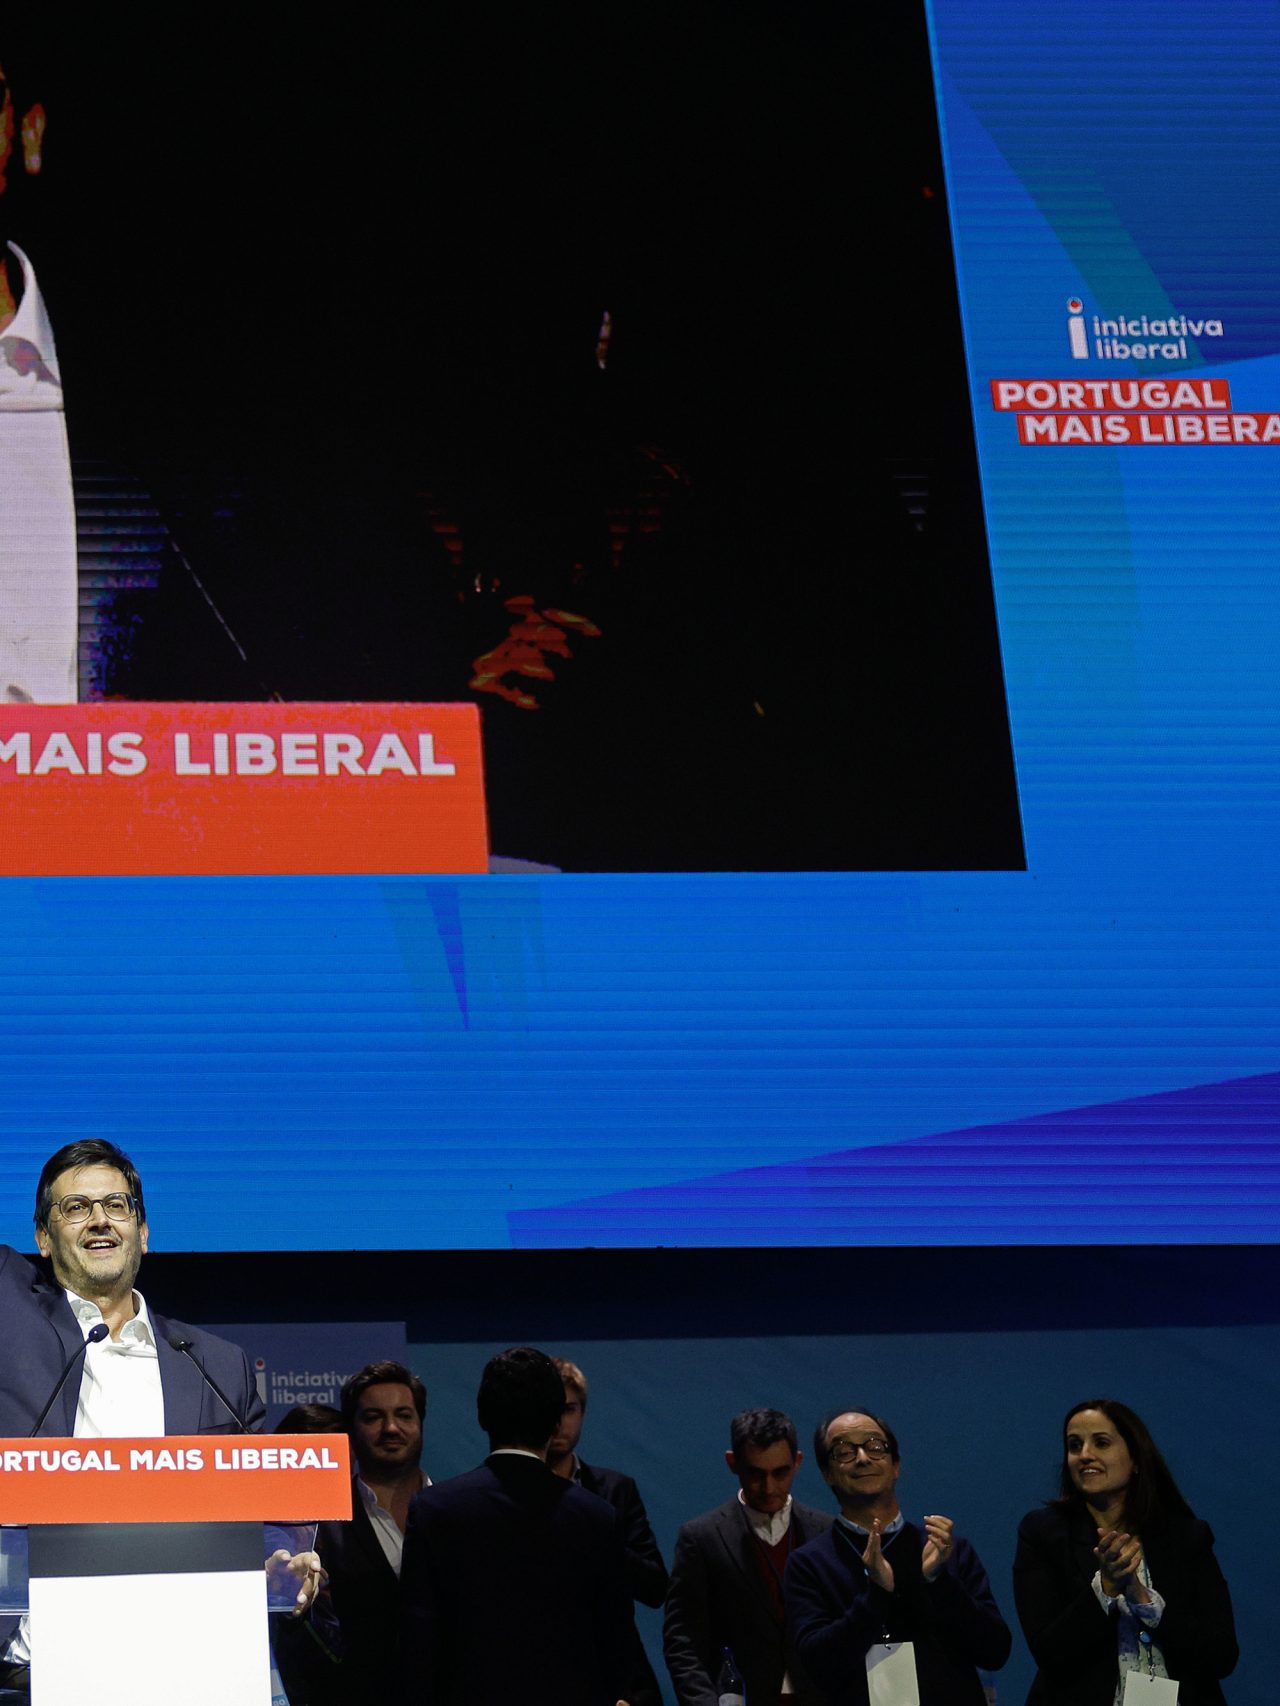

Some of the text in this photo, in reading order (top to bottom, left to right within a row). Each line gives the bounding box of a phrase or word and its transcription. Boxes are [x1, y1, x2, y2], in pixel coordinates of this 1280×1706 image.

[1093, 315, 1224, 337] iniciativa
[1096, 338, 1187, 360] liberal
[997, 381, 1227, 409] PORTUGAL
[1023, 415, 1131, 443] MAIS
[174, 733, 456, 776] LIBERAL
[271, 1371, 352, 1387] iniciativ
[272, 1389, 335, 1405] liberal
[130, 1449, 204, 1471] MAIS
[214, 1448, 339, 1469] LIBERAL
